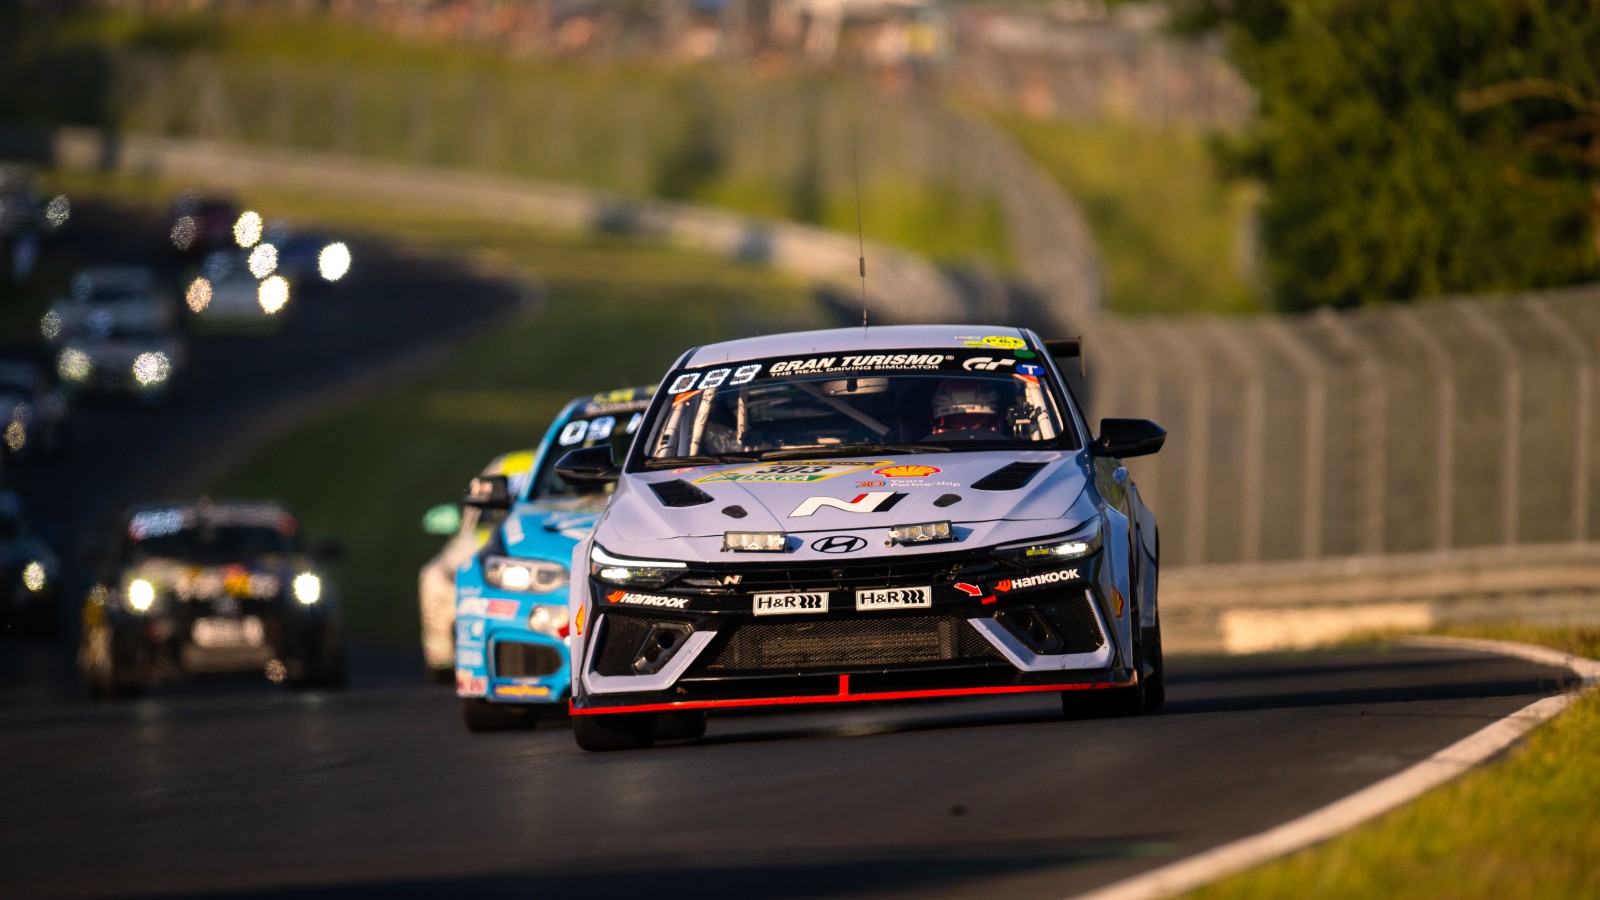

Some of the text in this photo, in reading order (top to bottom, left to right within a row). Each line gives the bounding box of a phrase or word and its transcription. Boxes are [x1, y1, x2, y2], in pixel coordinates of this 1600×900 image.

[769, 357, 836, 373] GRAN
[1021, 364, 1039, 375] T
[667, 363, 763, 395] 089
[755, 465, 832, 474] 303
[758, 596, 797, 609] H&R
[860, 591, 900, 604] H&R
